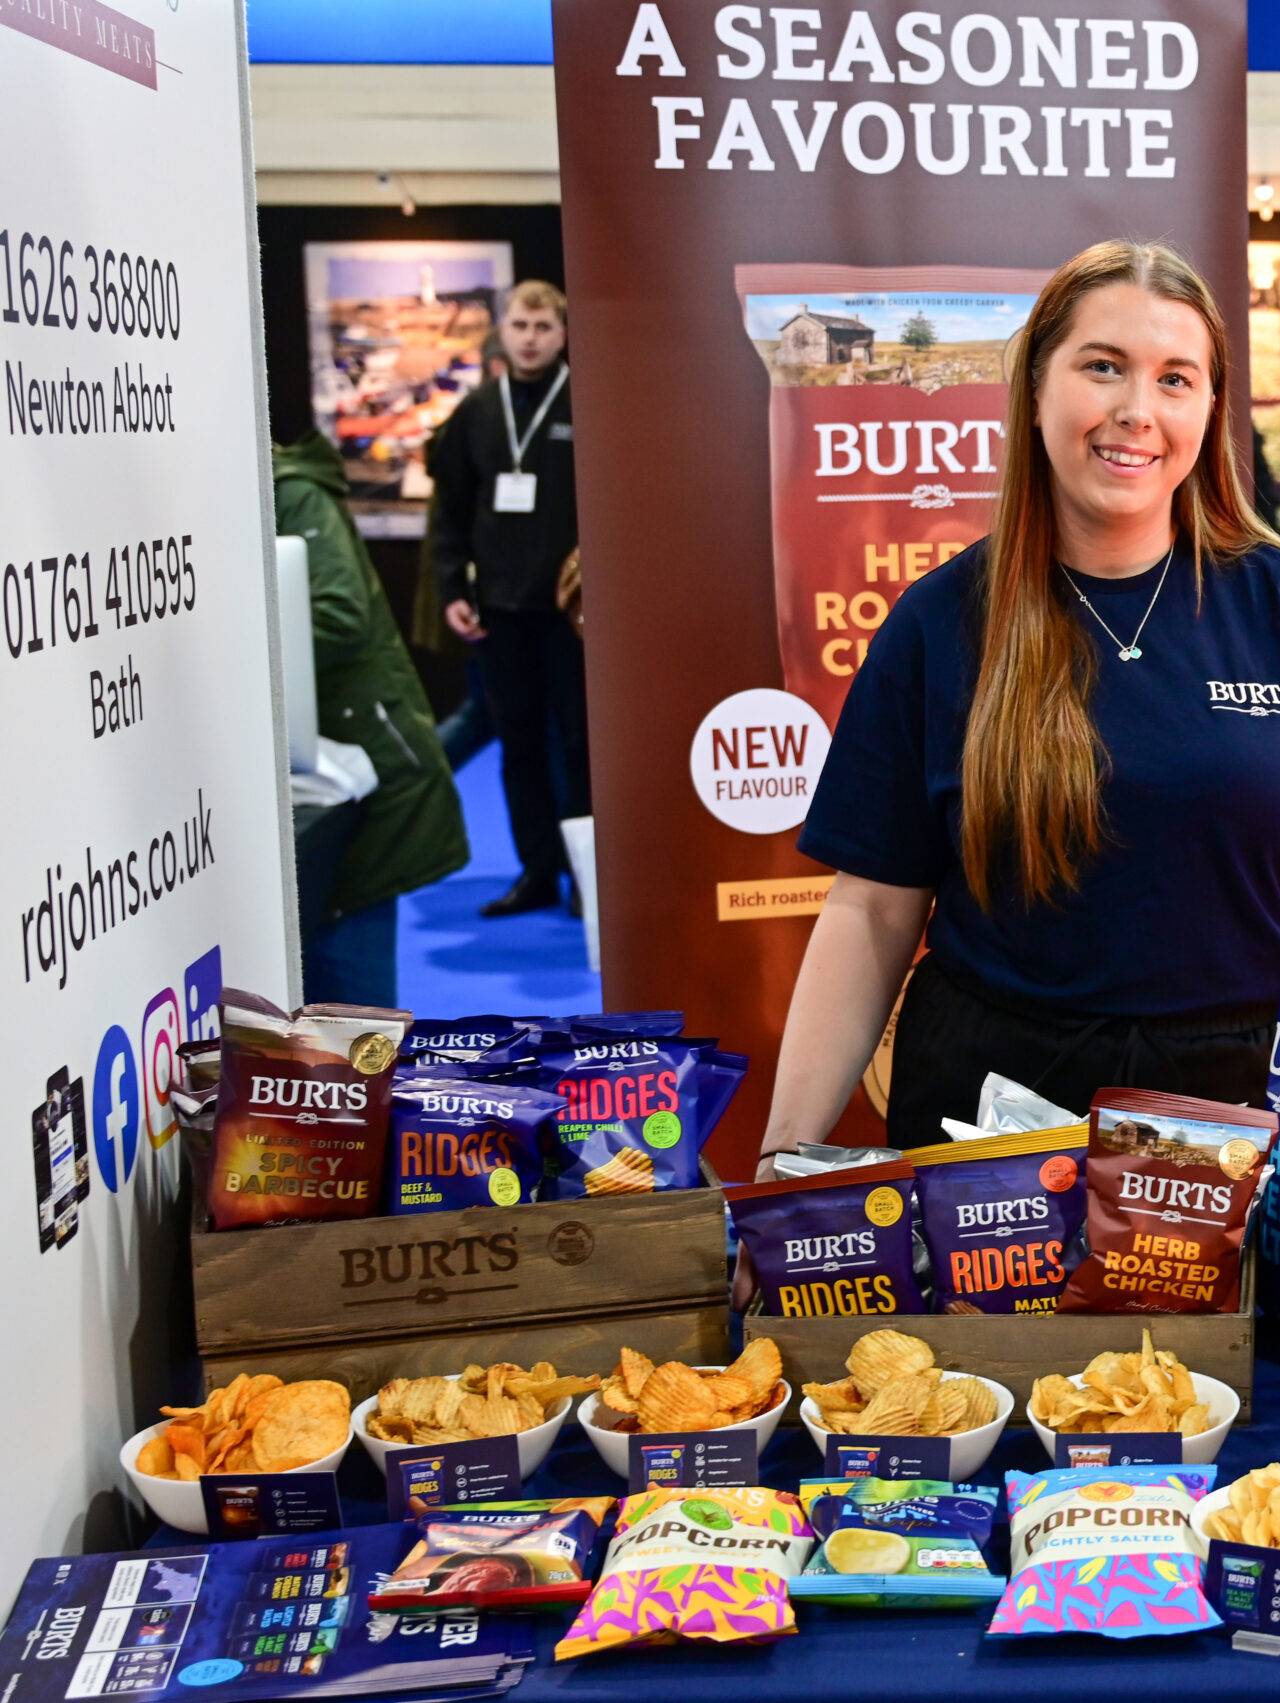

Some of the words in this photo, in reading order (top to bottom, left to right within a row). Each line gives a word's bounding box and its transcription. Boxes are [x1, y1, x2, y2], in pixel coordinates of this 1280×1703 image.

[96, 16, 152, 69] MEATS
[616, 3, 687, 78] A
[714, 4, 1200, 92] SEASONED
[652, 96, 1177, 179] FAVOURITE
[84, 245, 180, 341] 368800
[5, 360, 106, 436] Newton
[113, 362, 175, 433] Abbot
[813, 420, 1005, 477] BURT
[3, 552, 99, 660] 01761
[105, 535, 196, 630] 410595
[90, 654, 143, 739] Bath
[711, 724, 809, 771] NEW
[716, 776, 808, 801] FLAVOUR
[22, 788, 215, 990] rdjohns.co.uk
[728, 890, 768, 908] Rich
[411, 1033, 496, 1049] BURTS
[249, 1076, 368, 1110] BURTS
[422, 1095, 514, 1119] BURTS
[556, 1071, 680, 1121] RIDGES
[558, 1123, 593, 1134] REAPER
[595, 1121, 625, 1132] CHILLI
[568, 1132, 591, 1142] LIME
[309, 1139, 366, 1151] EDITION
[401, 1131, 514, 1178] RIDGES
[259, 1152, 345, 1177] SPICY
[222, 1172, 370, 1200] BARBECUE
[401, 1183, 425, 1194] BEEF
[425, 1182, 433, 1192] &
[401, 1193, 443, 1205] MUSTARD
[1119, 1171, 1232, 1213] BURTS
[956, 1196, 1050, 1228] BURTS
[339, 1232, 521, 1289] BURTS
[784, 1231, 877, 1263] BURTS
[1133, 1234, 1201, 1261] HERB
[950, 1240, 1066, 1294] RIDGES
[1104, 1251, 1220, 1282] ROASTED
[779, 1275, 898, 1317] RIDGES
[1103, 1273, 1215, 1302] CHICKEN
[409, 1480, 440, 1495] RIDGES
[648, 1468, 679, 1480] RIDGES
[462, 1514, 542, 1524] BURTS
[1024, 1507, 1193, 1556] POPCORN
[612, 1520, 793, 1559] POPCORN
[1110, 1534, 1176, 1544] SALTED
[36, 1605, 86, 1661] BURTS
